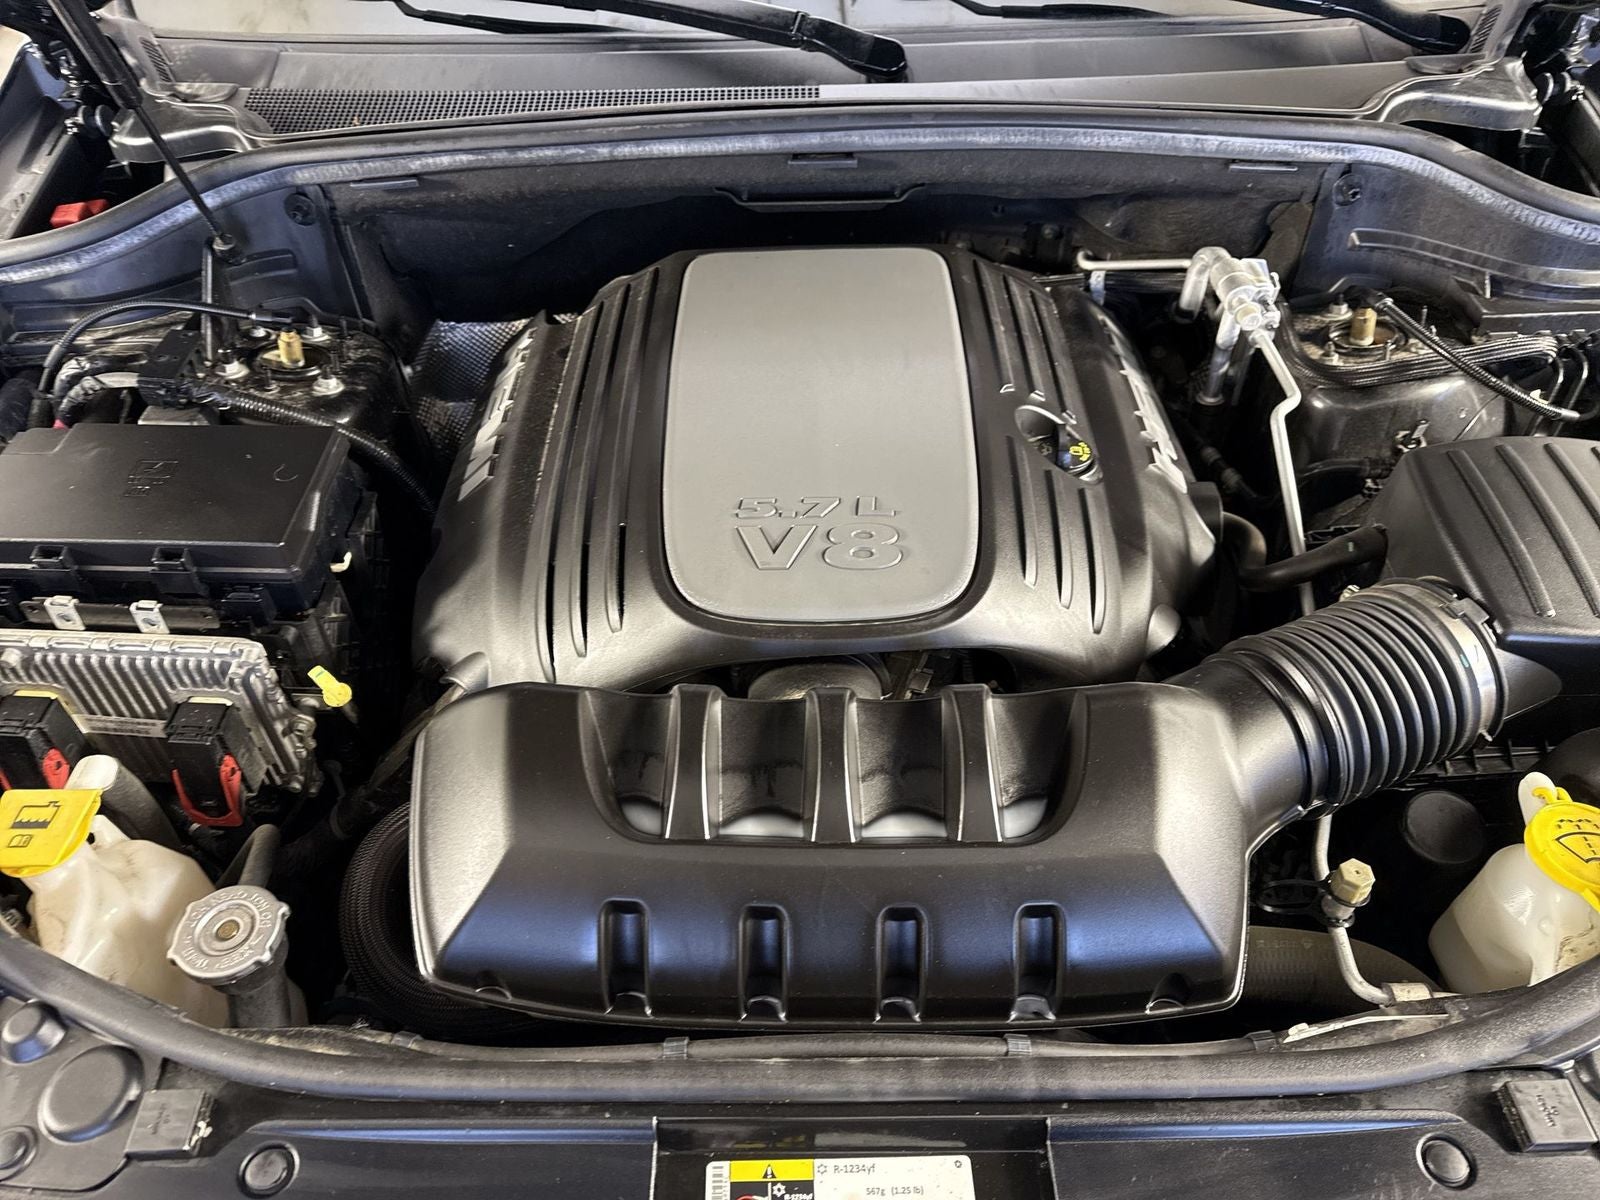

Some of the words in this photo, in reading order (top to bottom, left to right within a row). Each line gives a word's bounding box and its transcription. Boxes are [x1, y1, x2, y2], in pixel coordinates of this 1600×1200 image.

[735, 523, 904, 571] V8
[833, 1163, 876, 1175] R-1234yf
[866, 1187, 886, 1196] 567g
